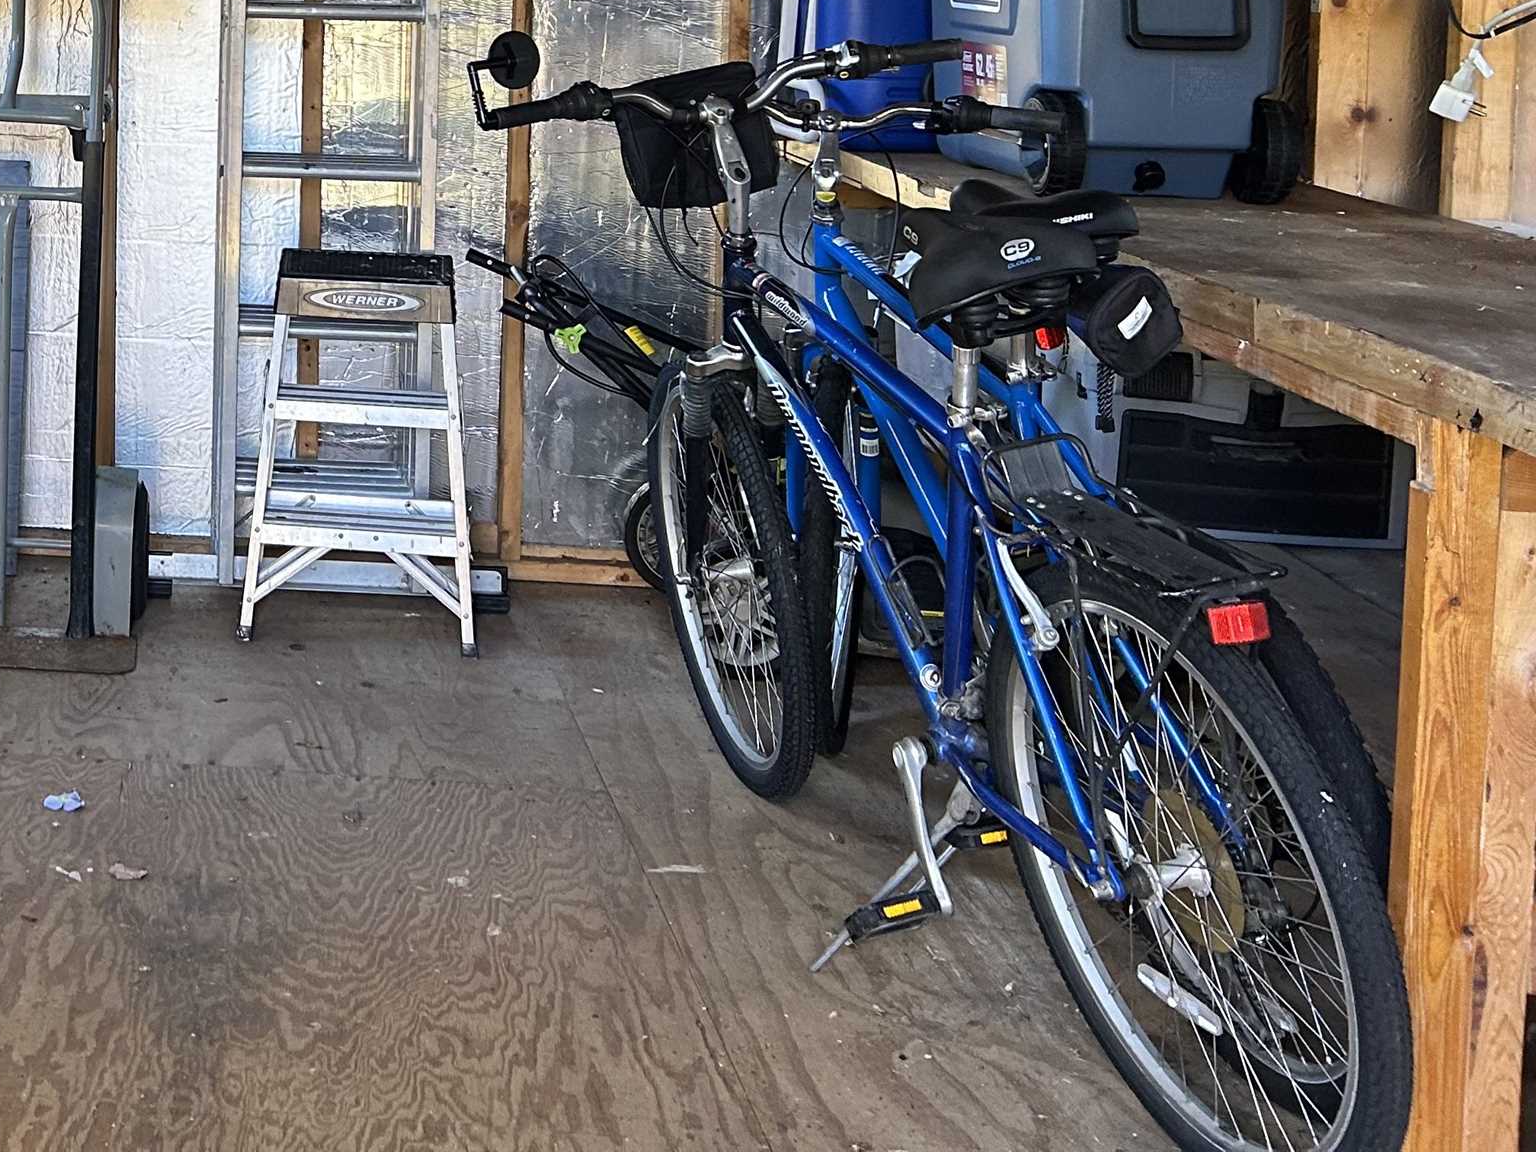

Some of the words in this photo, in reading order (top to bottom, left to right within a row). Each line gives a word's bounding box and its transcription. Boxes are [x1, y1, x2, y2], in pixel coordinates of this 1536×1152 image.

[903, 225, 919, 245] C9
[1004, 240, 1030, 257] C9
[331, 294, 398, 307] WERNER
